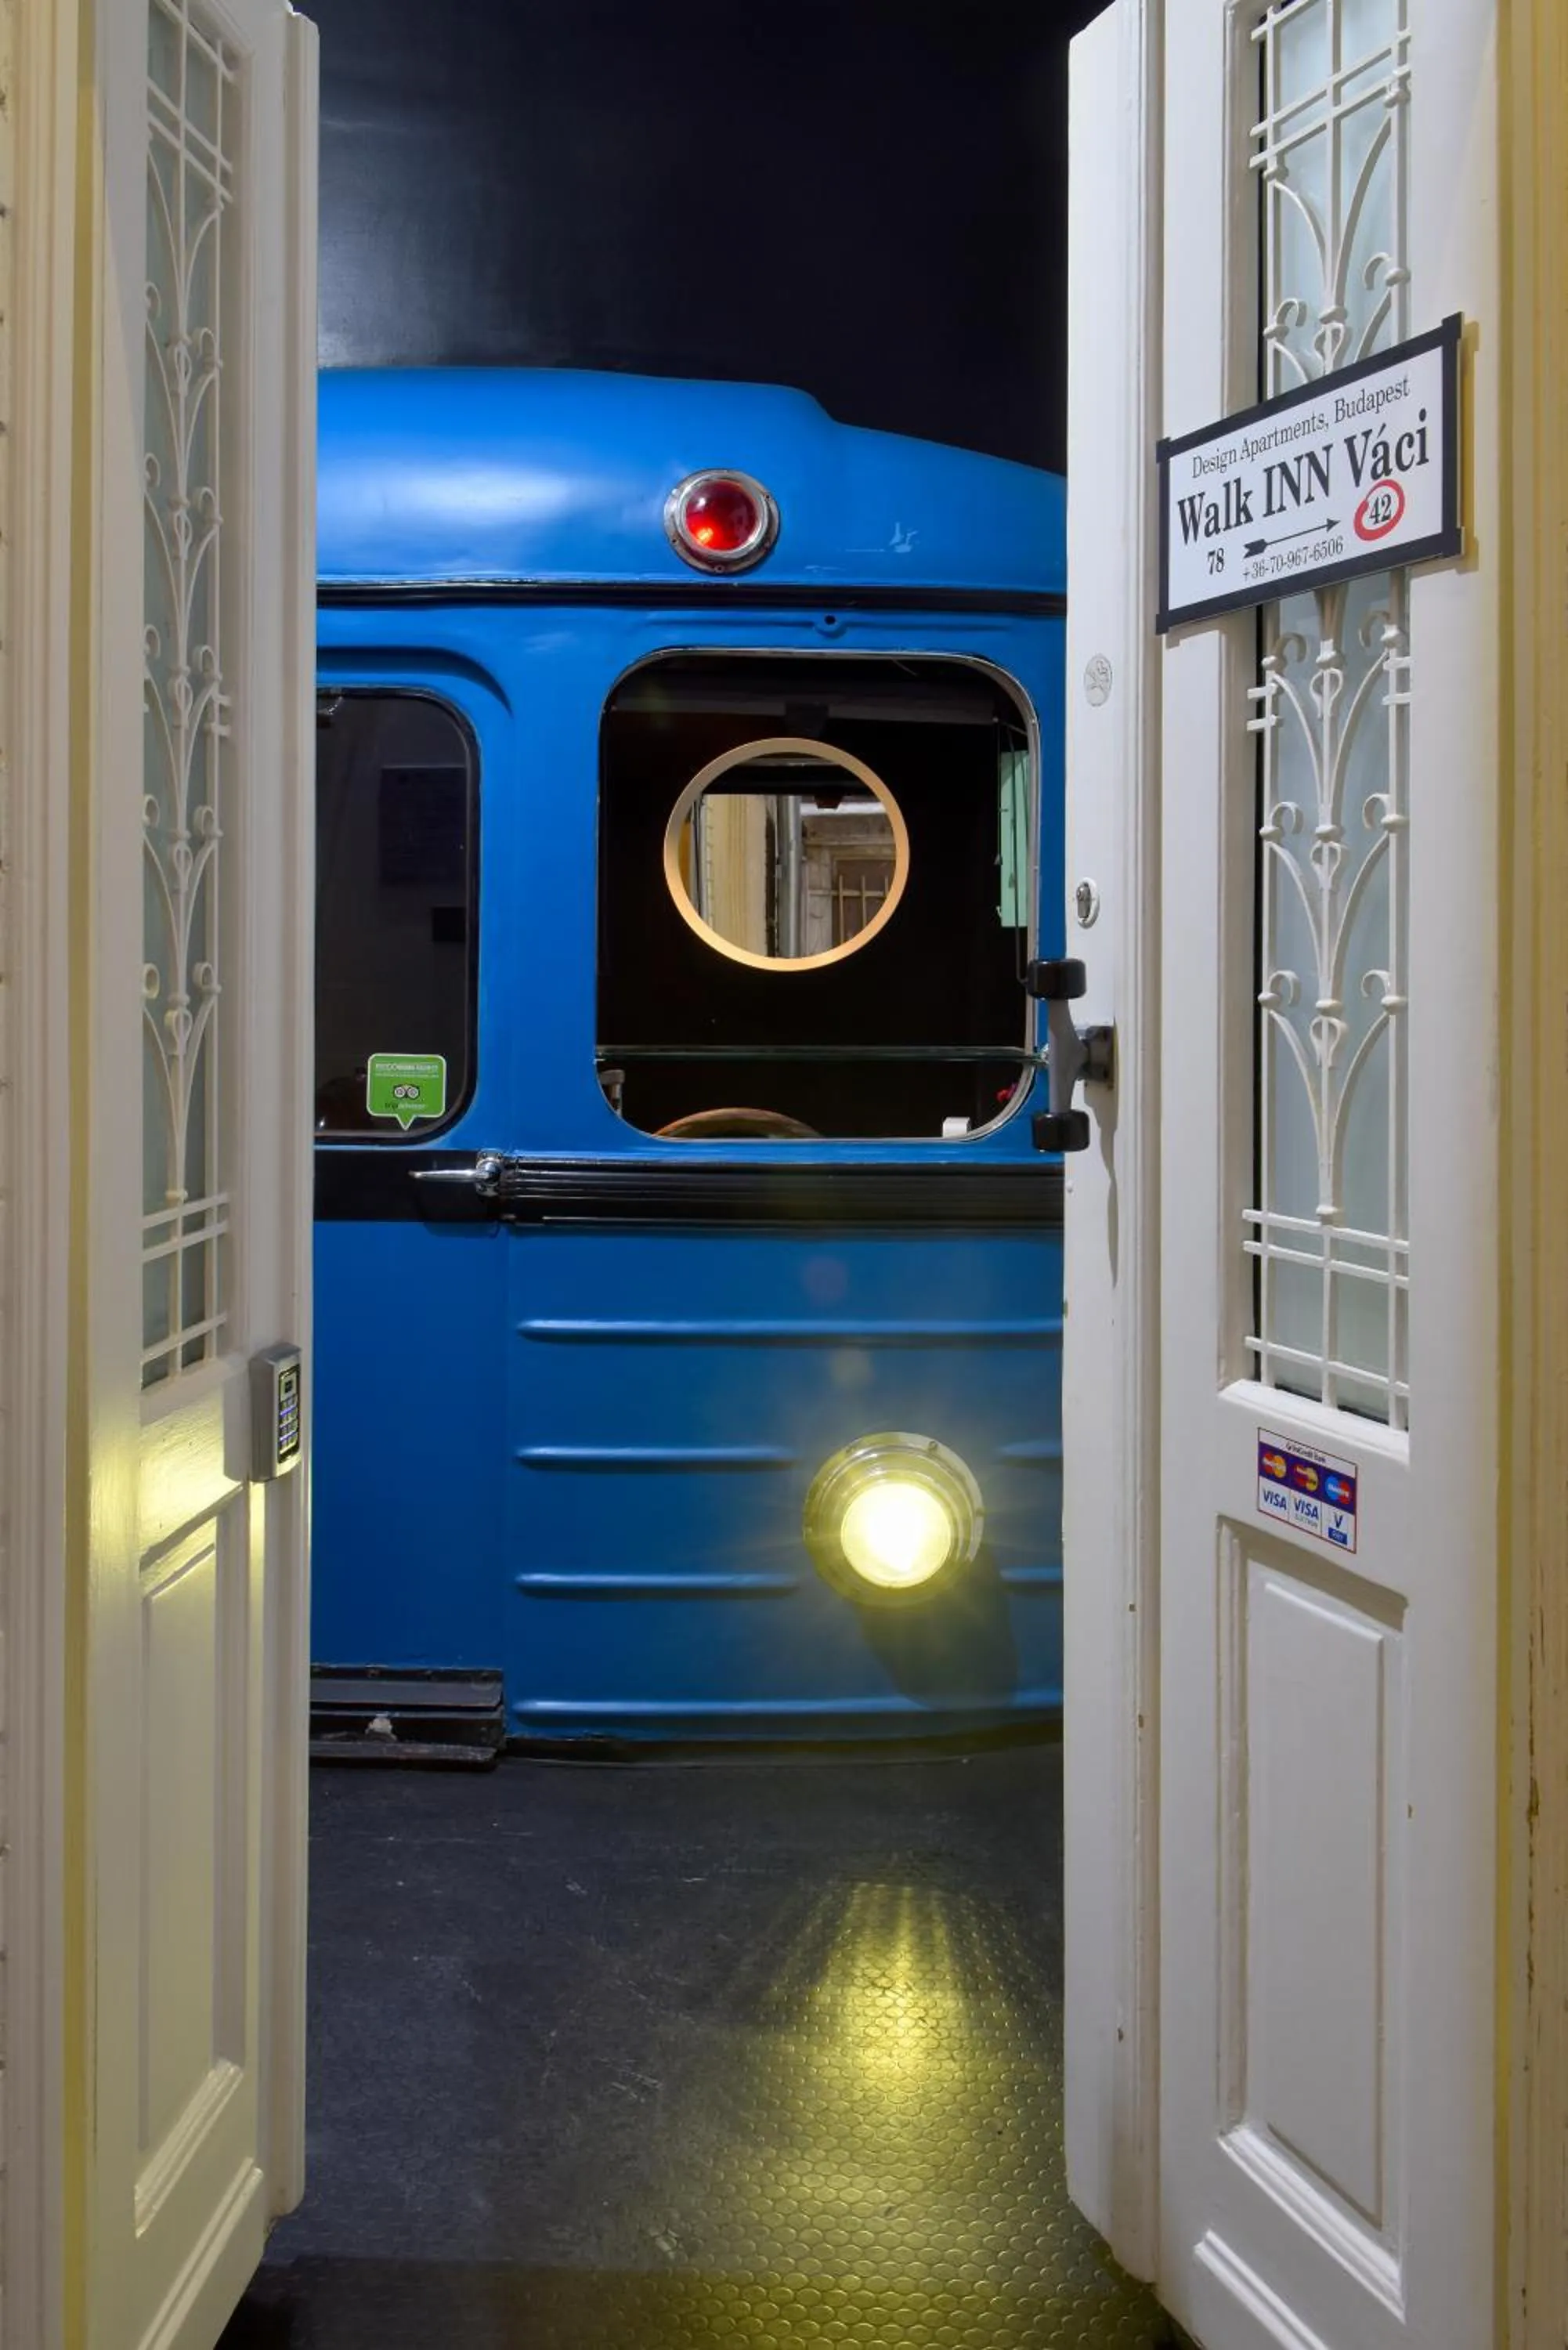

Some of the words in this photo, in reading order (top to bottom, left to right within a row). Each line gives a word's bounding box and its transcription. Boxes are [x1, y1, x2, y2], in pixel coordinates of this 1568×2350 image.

[1192, 448, 1237, 479] Design
[1240, 411, 1329, 462] Apartments,
[1334, 378, 1411, 424] Budapest
[1177, 476, 1254, 545] Walk
[1263, 443, 1334, 518] INN
[1343, 407, 1429, 488] Váci
[1368, 493, 1392, 525] 42
[1207, 547, 1225, 575] 78
[1242, 534, 1344, 581] +36-70-967-6506
[1263, 1488, 1287, 1510] VISA
[1294, 1497, 1319, 1520] VISA
